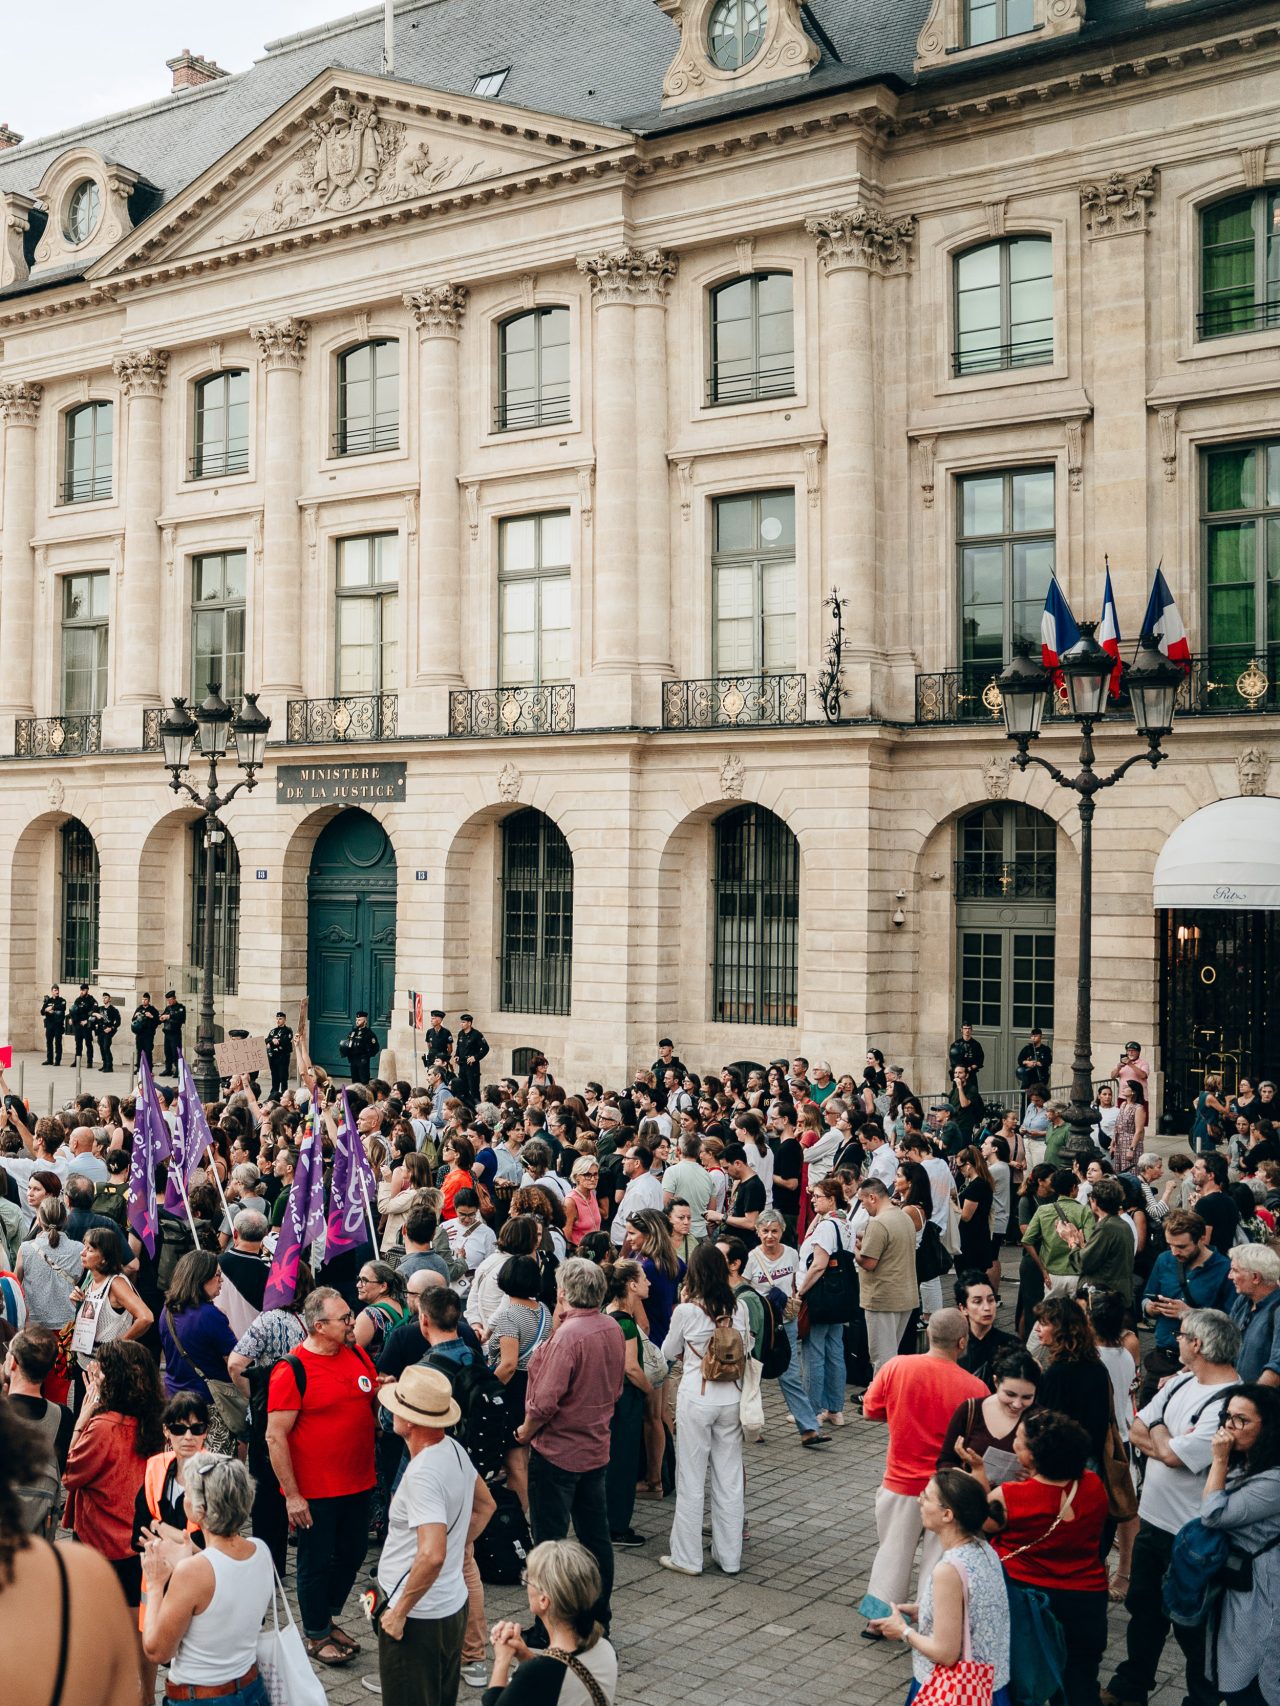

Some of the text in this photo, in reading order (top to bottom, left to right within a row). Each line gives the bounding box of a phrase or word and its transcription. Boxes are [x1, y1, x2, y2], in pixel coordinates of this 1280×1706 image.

[300, 768, 380, 781] MINISTERE
[287, 785, 395, 798] DE LA JUSTICE
[258, 871, 265, 879] 13
[418, 871, 426, 880] 13
[1213, 886, 1247, 899] Ritz
[221, 1040, 258, 1054] BURN
[220, 1049, 263, 1065] ALL THE
[220, 1060, 265, 1075] RAPISTS
